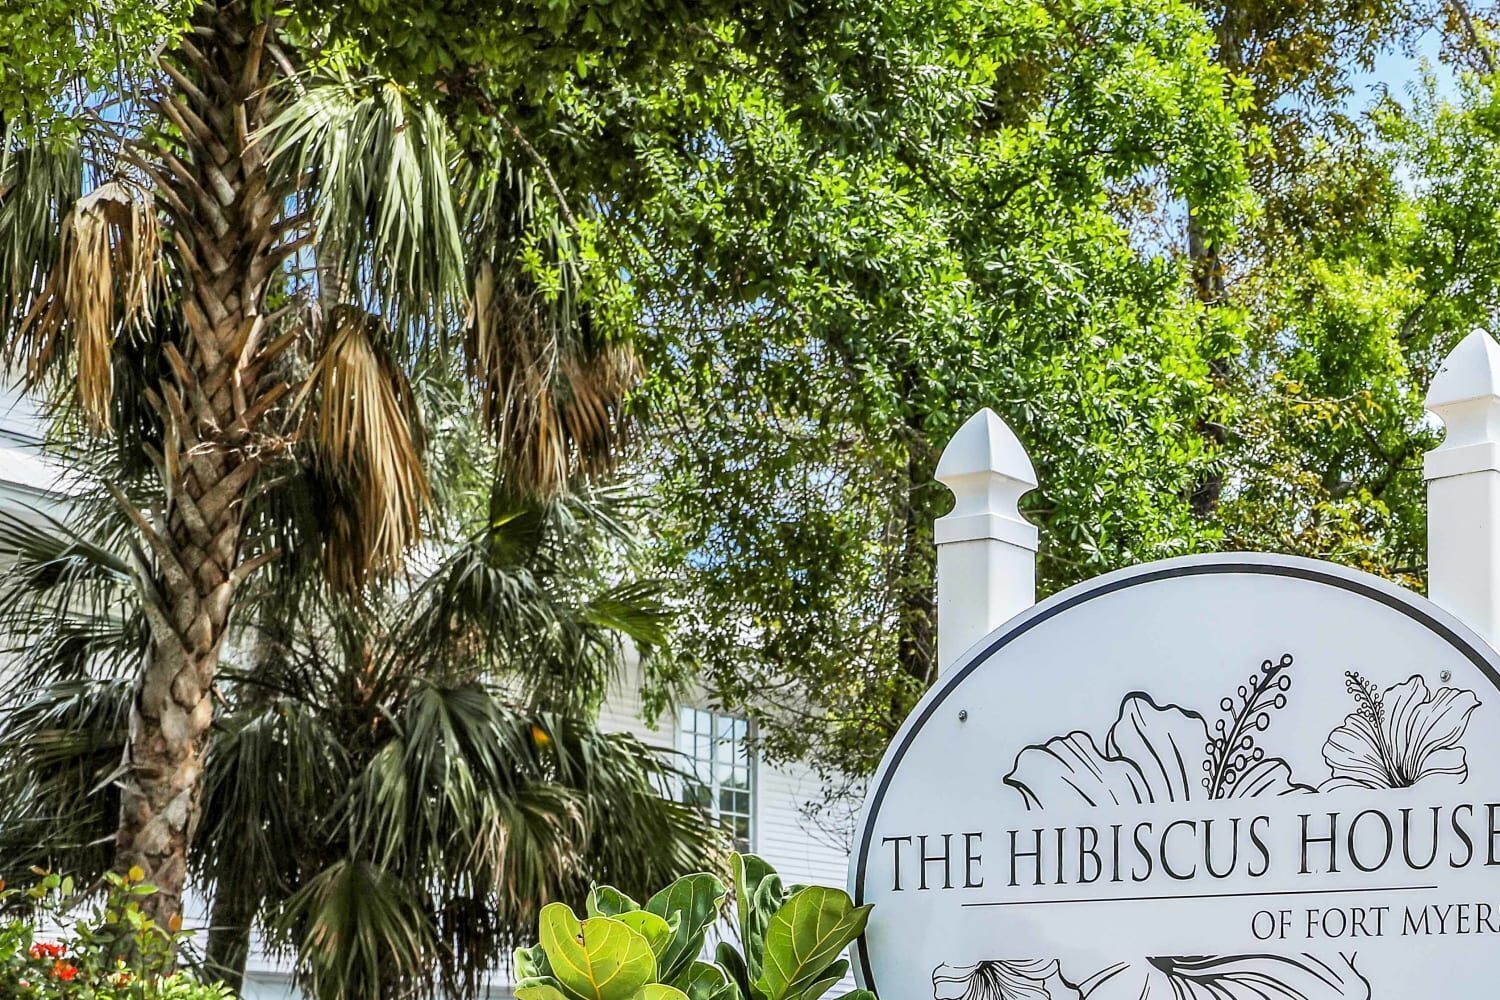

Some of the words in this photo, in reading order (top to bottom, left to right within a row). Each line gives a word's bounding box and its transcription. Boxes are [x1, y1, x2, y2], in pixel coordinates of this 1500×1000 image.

[881, 830, 984, 892] THE
[1006, 815, 1271, 888] HIBISCUS
[1251, 908, 1293, 941] OF
[1304, 906, 1390, 940] FORT
